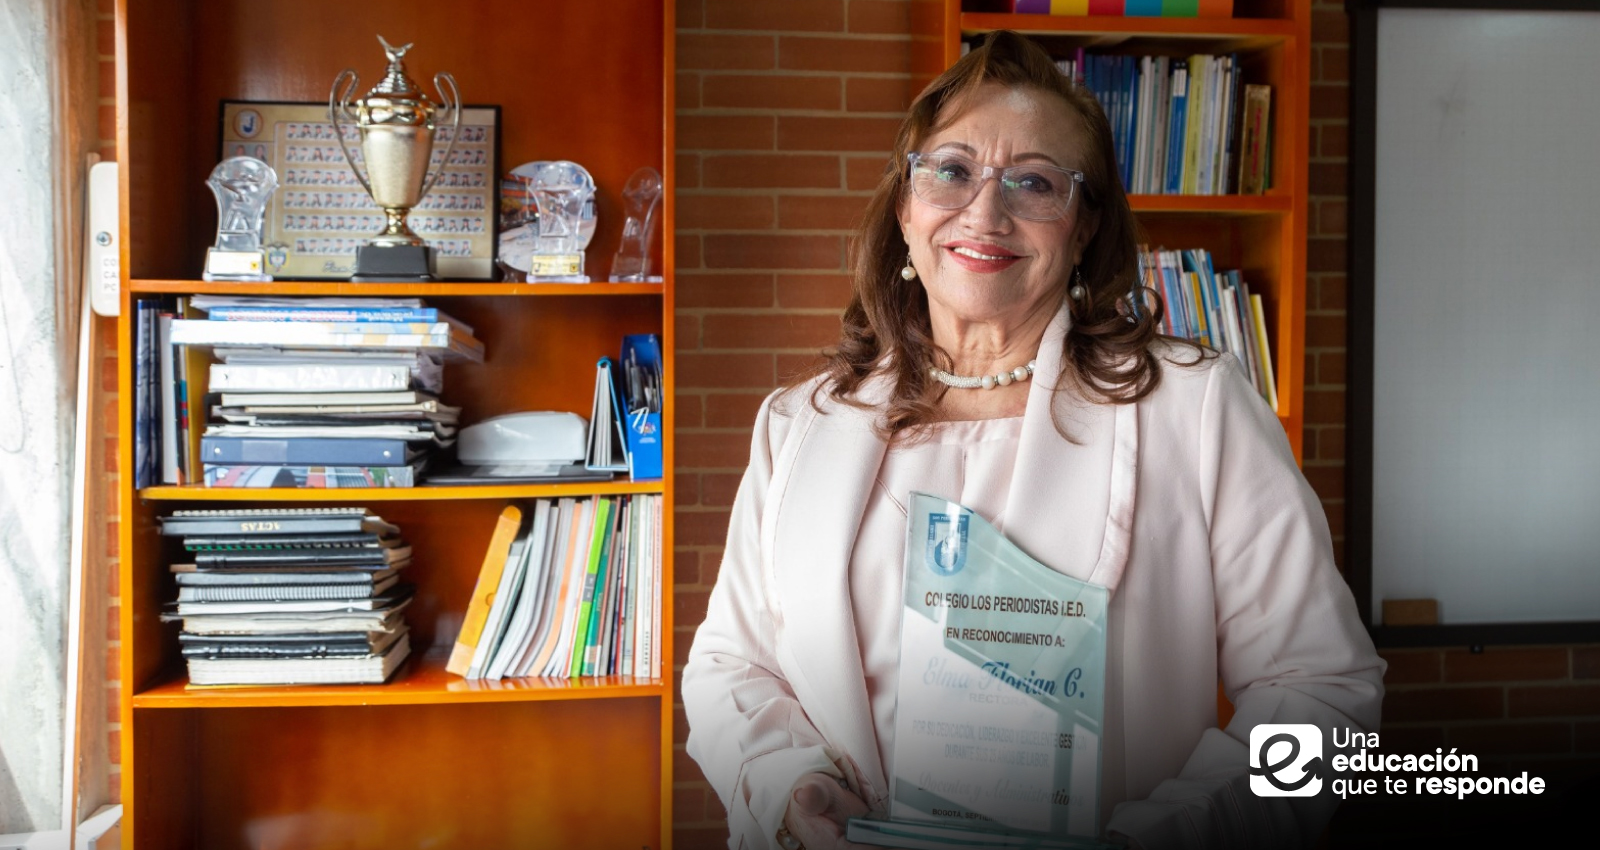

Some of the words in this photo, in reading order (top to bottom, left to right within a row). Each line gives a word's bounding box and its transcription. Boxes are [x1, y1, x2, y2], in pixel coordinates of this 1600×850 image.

[103, 257, 117, 267] CO
[103, 270, 118, 279] CA
[925, 591, 969, 609] COLEGIO
[971, 595, 991, 611] LOS
[993, 596, 1059, 616] PERIODISTAS
[1061, 601, 1086, 617] I.E.D.
[946, 627, 960, 639] EN
[962, 628, 1053, 647] RECONOCIMIENTO
[1054, 635, 1065, 648] A:
[923, 656, 970, 689] Elma
[978, 661, 1057, 695] Florian
[1063, 667, 1085, 698] C.
[968, 692, 1030, 706] RECTORA
[912, 719, 926, 735] POR
[927, 720, 936, 736] SU
[978, 725, 1015, 743] LIDERAZGO
[945, 743, 975, 760] DURANTE
[985, 778, 1084, 808] Administrativos
[932, 807, 964, 819] BOGOTÁ,
